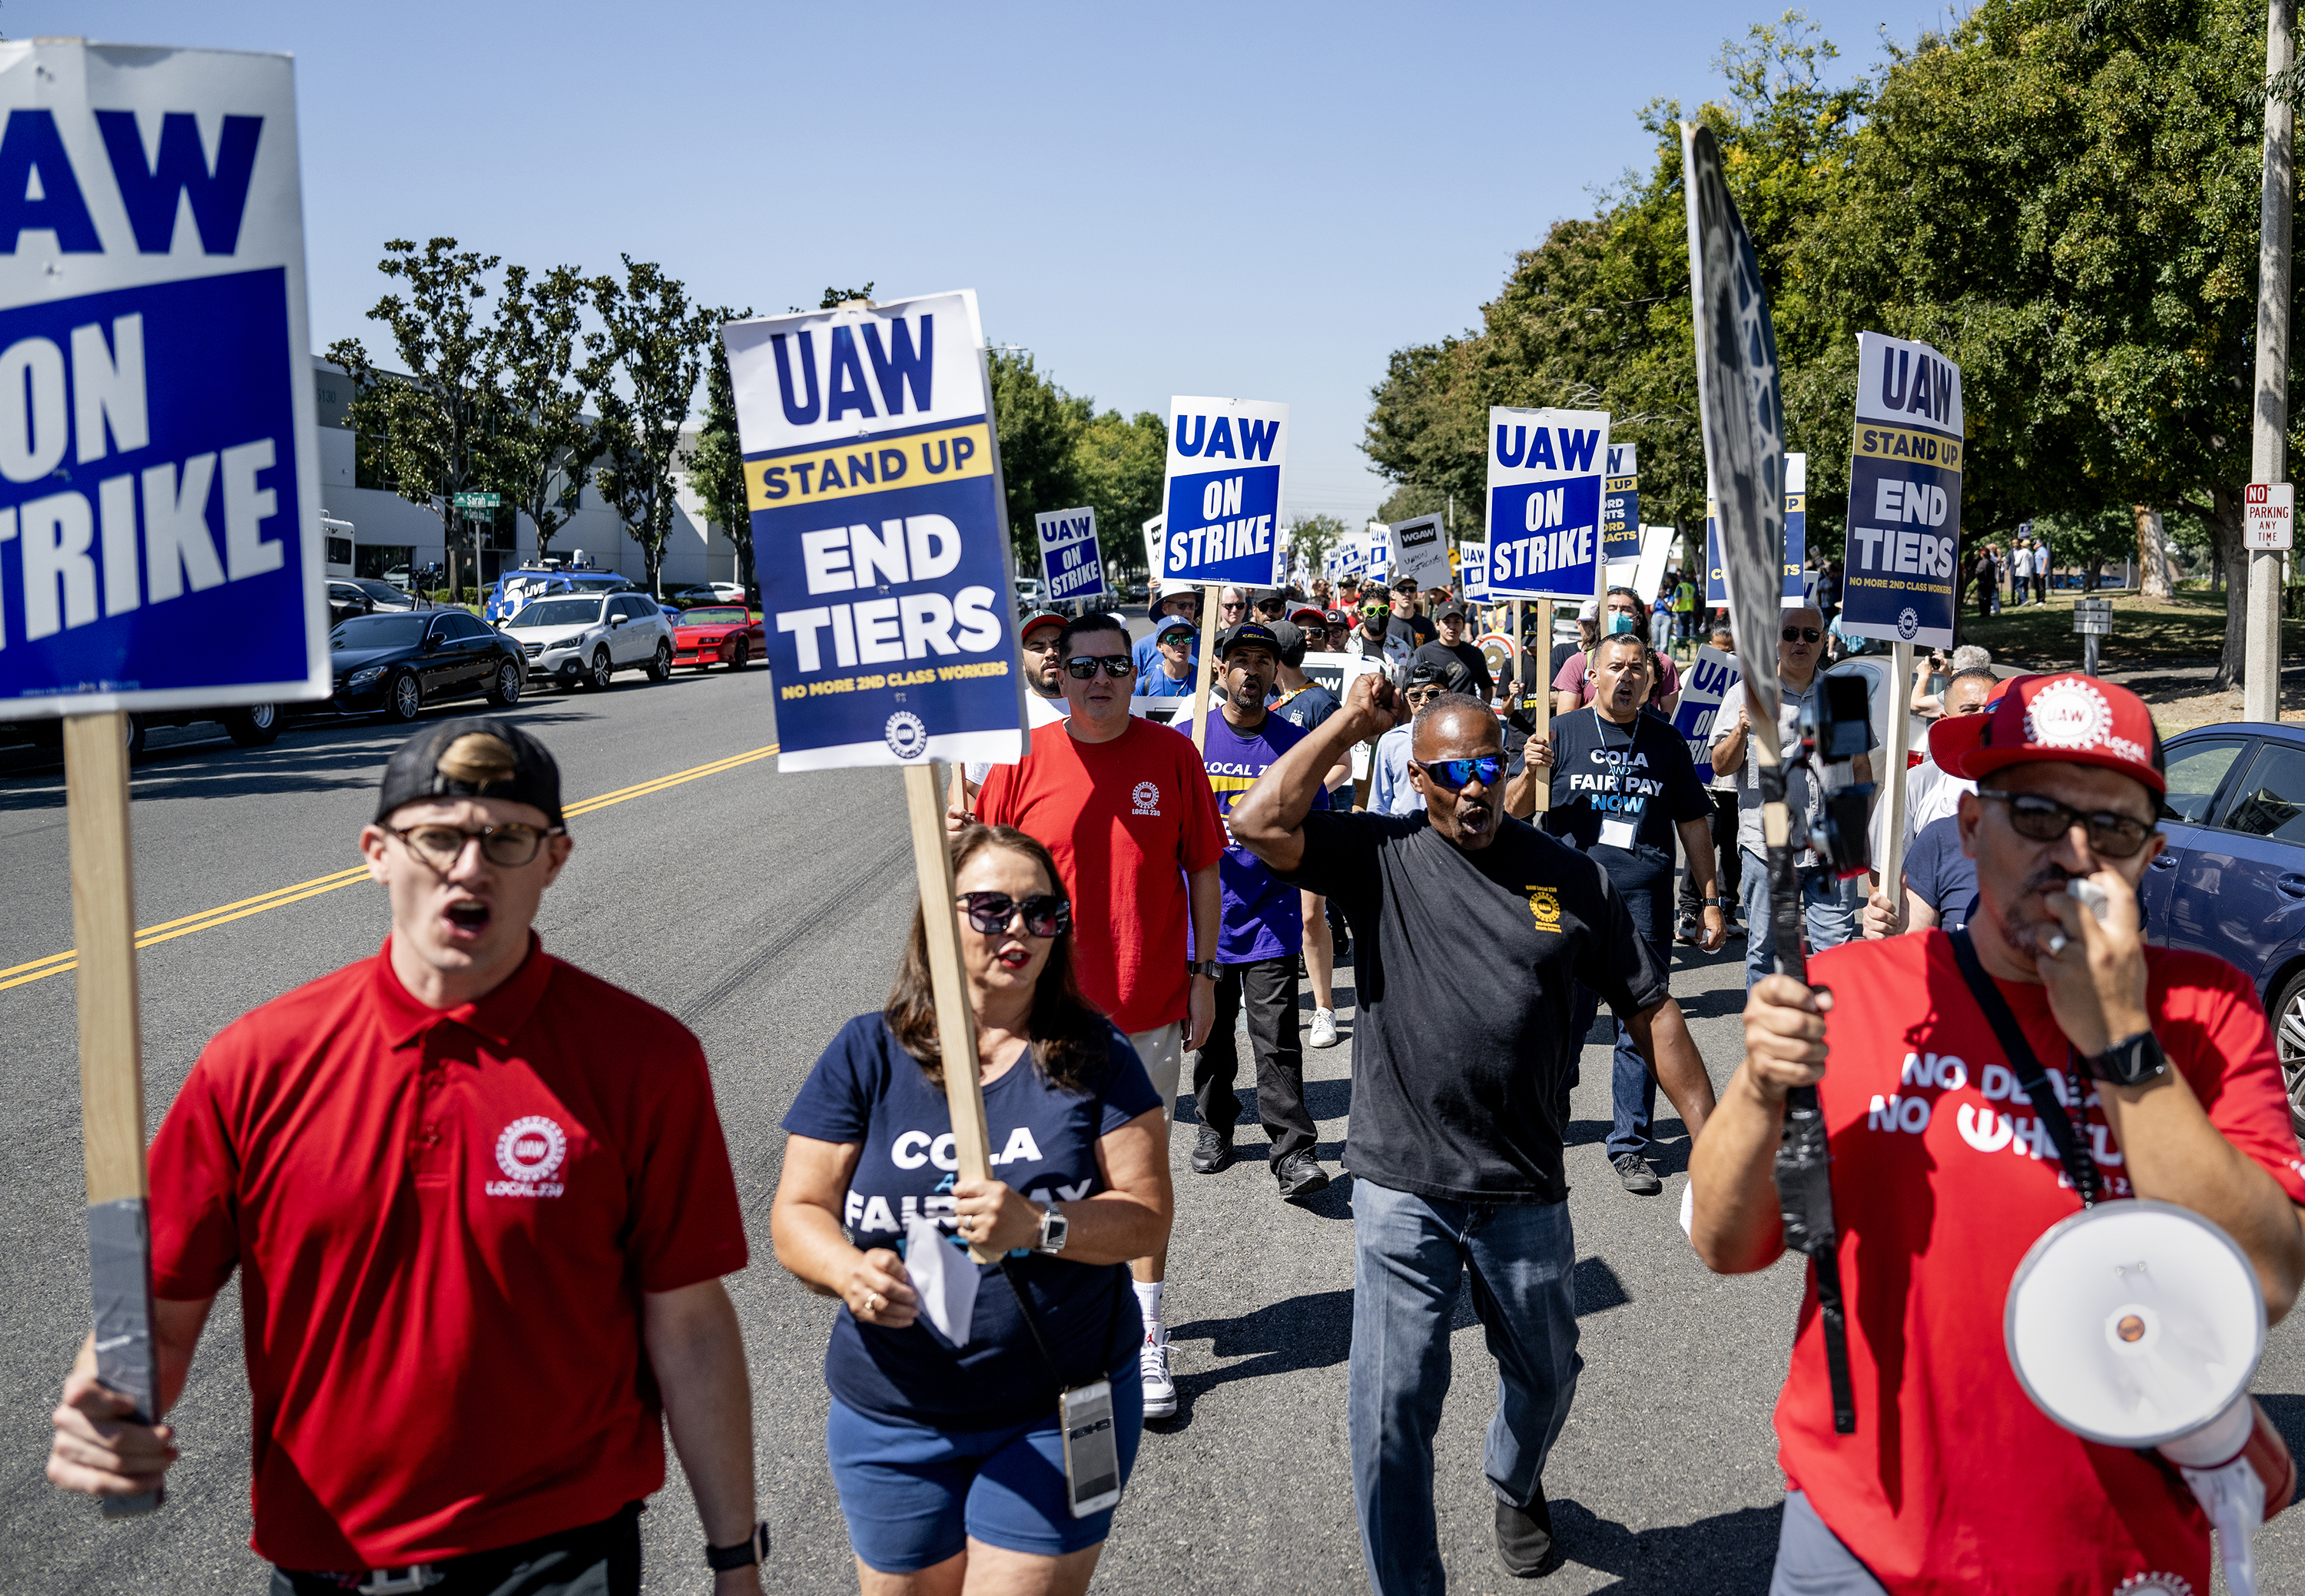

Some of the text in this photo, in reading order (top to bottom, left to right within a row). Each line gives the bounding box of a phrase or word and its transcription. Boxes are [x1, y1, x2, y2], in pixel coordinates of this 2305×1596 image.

[0, 108, 264, 256] AW
[771, 314, 934, 426] UAW
[1882, 346, 1952, 425] UAW
[0, 312, 150, 483] ON
[1176, 414, 1280, 462] UAW
[1497, 424, 1600, 472] UAW
[1862, 430, 1958, 466] STAND UP
[764, 436, 975, 500] STAND UP
[1614, 479, 1633, 489] UP
[467, 494, 486, 506] Sarah
[1203, 476, 1243, 521] ON
[1525, 487, 1564, 532] ON
[1875, 478, 1947, 527] END
[2249, 487, 2265, 501] NO
[2250, 506, 2289, 519] PARKING
[1041, 516, 1090, 543] UAW
[1169, 514, 1272, 572] STRIKE
[1402, 528, 1434, 543] WGAW
[2258, 533, 2277, 541] TIME
[2259, 521, 2277, 529] ANY
[0, 437, 284, 652] RIKE
[801, 513, 962, 596] END
[1062, 546, 1081, 569] ON
[1340, 543, 1356, 552] UAW
[1494, 525, 1593, 582] STRIKE
[1854, 526, 1954, 579] TIERS
[524, 581, 547, 598] LIVE
[1052, 560, 1099, 597] STRIKE
[1471, 568, 1482, 583] ON
[1849, 577, 1952, 595] NO MORE 2ND CLASS WORKERS
[776, 586, 1002, 673] TIERS
[781, 660, 1009, 700] NO MORE 2ND CLASS WORKERS
[2048, 708, 2085, 722] UAW
[1205, 762, 1252, 775] LOCAL
[1590, 749, 1649, 768] COLA
[1608, 766, 1631, 775] AND
[1570, 774, 1663, 797] FAIR PAY
[1591, 794, 1644, 813] NOW
[1902, 1053, 1968, 1090] NO
[1868, 1093, 1931, 1134] NO
[890, 1126, 1043, 1170] COA
